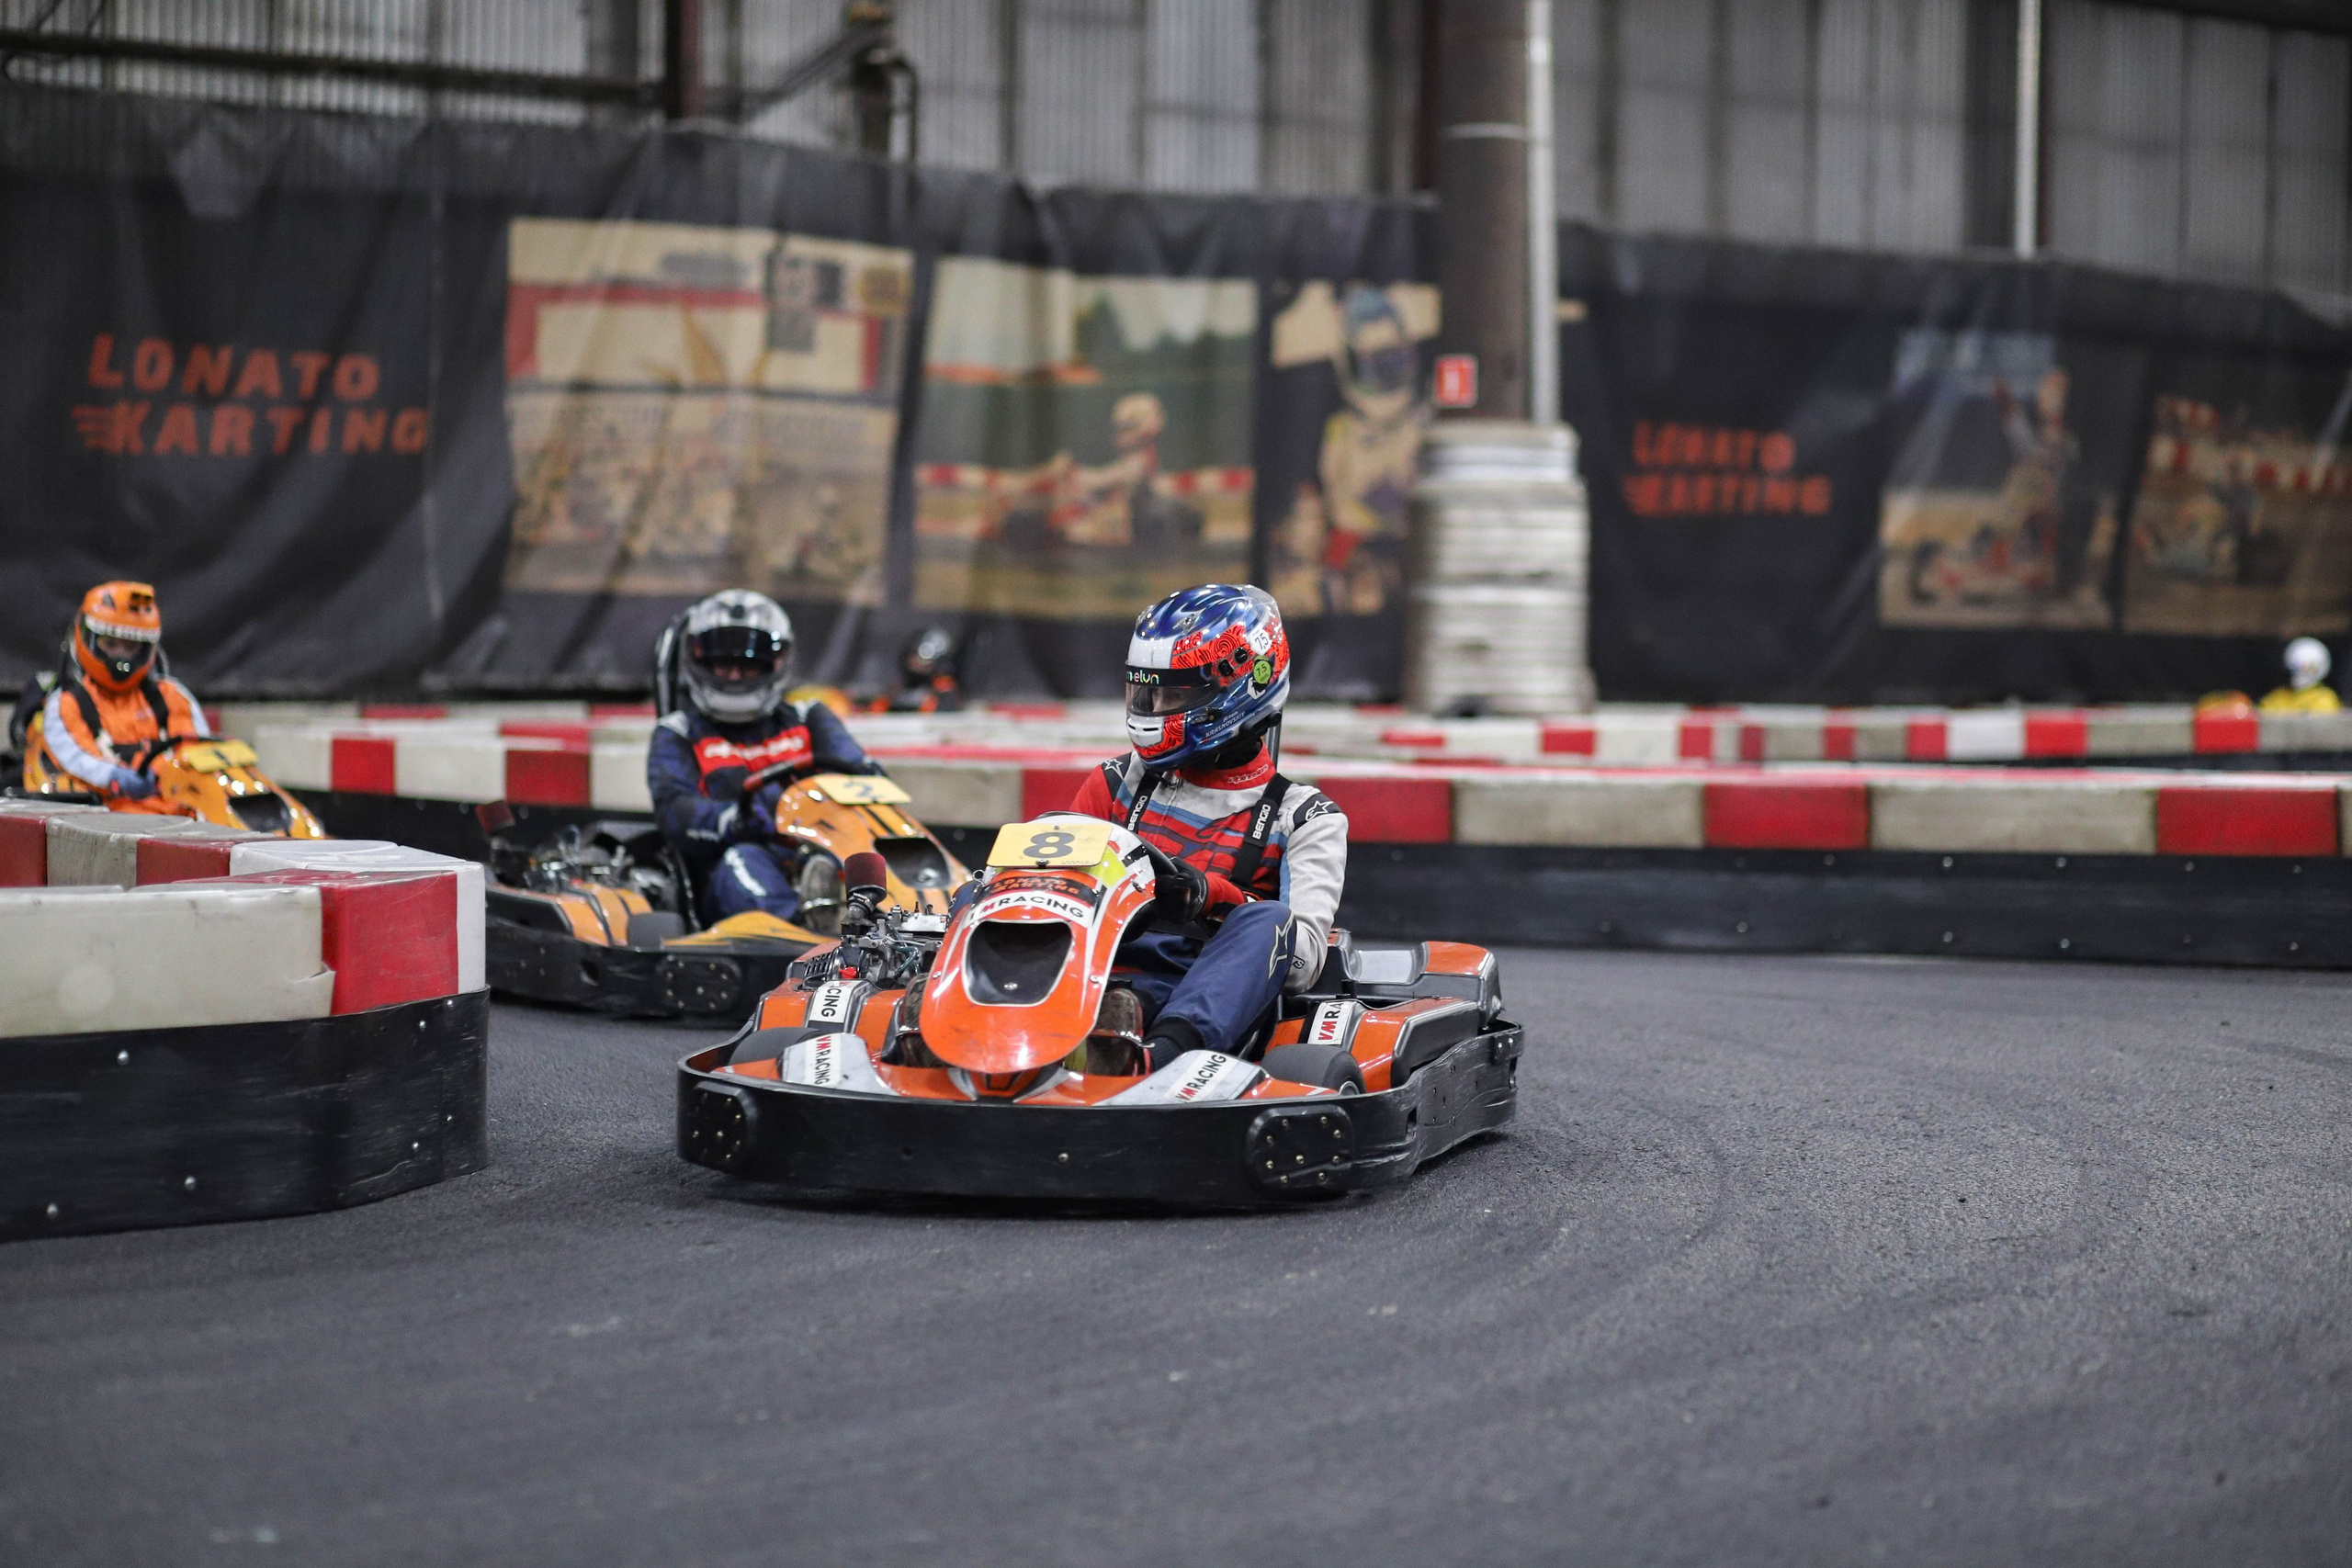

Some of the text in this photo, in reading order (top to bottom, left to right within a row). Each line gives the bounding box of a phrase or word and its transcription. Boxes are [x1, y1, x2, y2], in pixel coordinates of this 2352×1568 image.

[87, 333, 380, 401] LONATO
[101, 401, 429, 456] KARTING
[1127, 795, 1148, 831] BENGIO
[1252, 804, 1271, 840] BENGIO
[1023, 831, 1075, 858] 8
